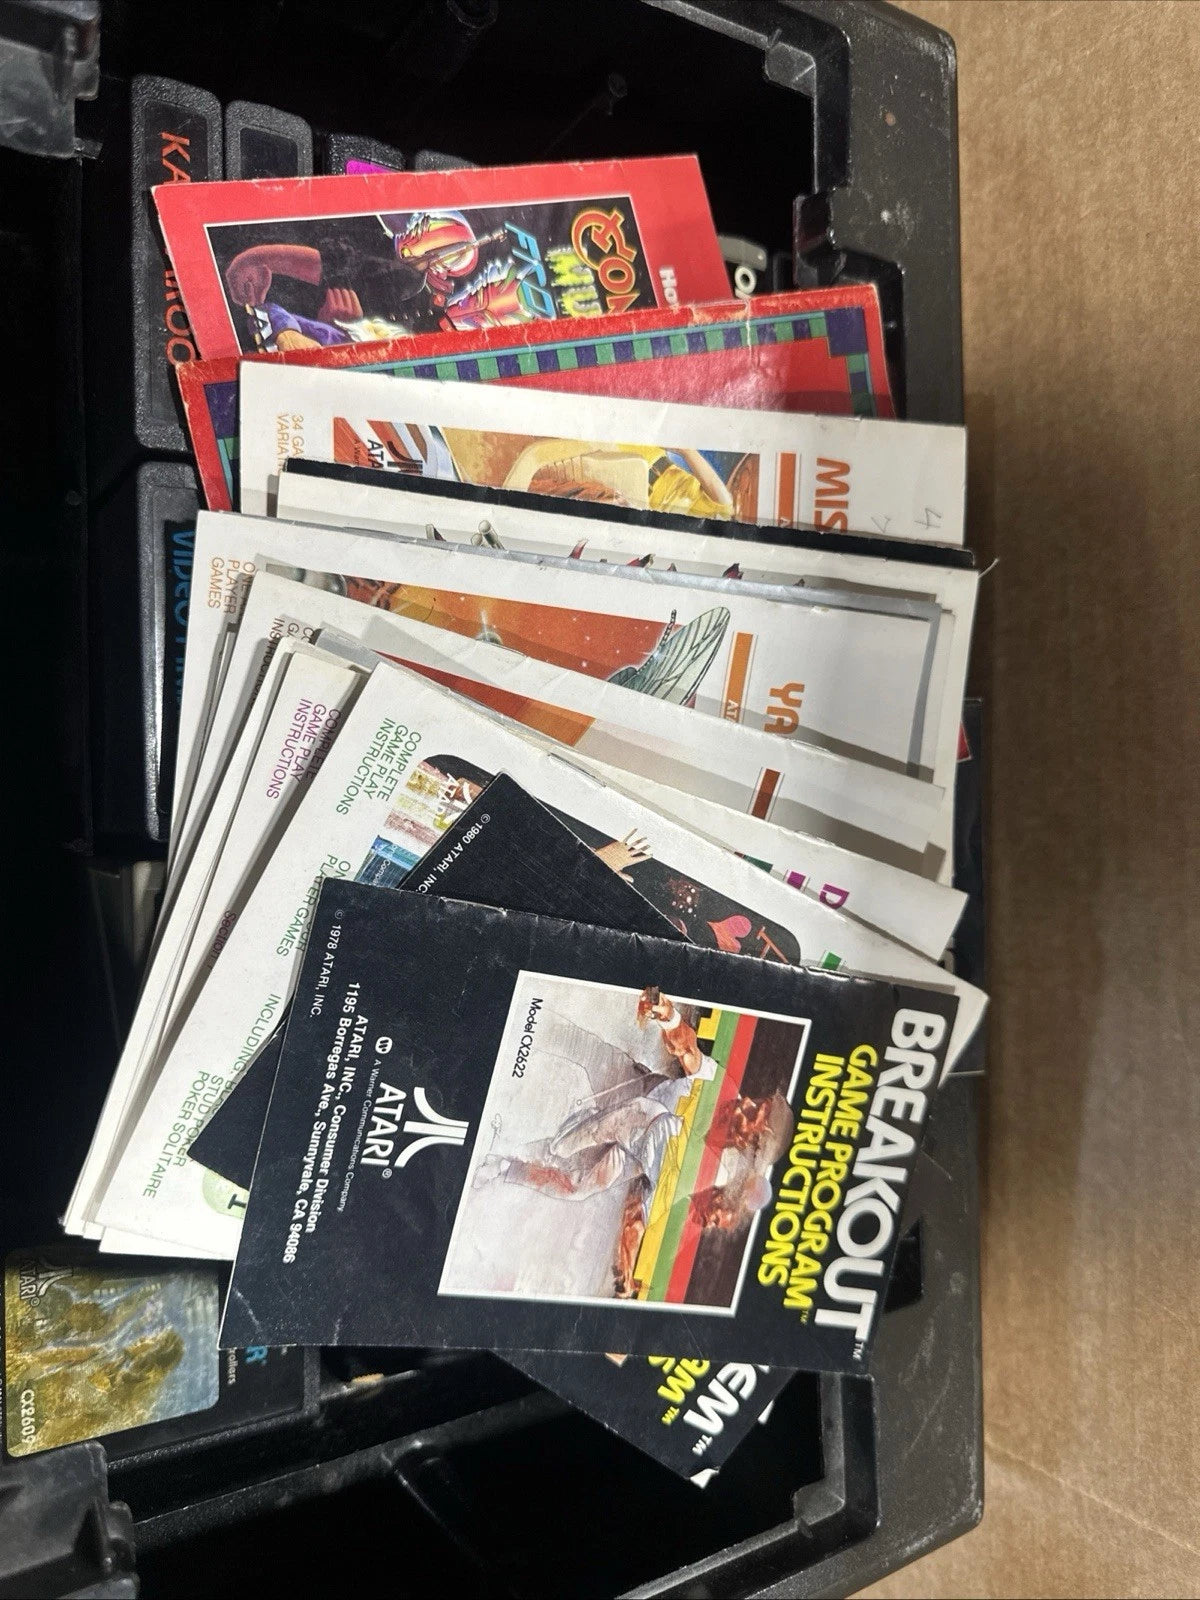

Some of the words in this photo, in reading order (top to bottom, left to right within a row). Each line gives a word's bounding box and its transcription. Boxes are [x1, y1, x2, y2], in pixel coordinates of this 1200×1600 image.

[291, 414, 305, 430] 34
[292, 436, 305, 457] GA
[814, 457, 851, 533] MIS
[208, 557, 225, 609] GAMES
[223, 560, 241, 615] PLAYER
[302, 703, 327, 744] GAME
[764, 682, 806, 736] YA
[266, 698, 312, 799] INSTRUCTIONS
[290, 747, 312, 784] PLAY
[305, 709, 342, 780] COMPLETE
[336, 717, 396, 815] INSTRUCTIONS
[377, 731, 422, 801] COMPLETE
[380, 724, 409, 766] GAME
[363, 765, 389, 800] PLAY
[432, 842, 464, 872] ATARI,
[461, 822, 484, 844] 1980
[415, 873, 438, 895] INC.
[276, 907, 311, 957] GAMES
[327, 924, 342, 950] 1978
[315, 951, 335, 991] ATARI,
[309, 994, 325, 1018] INC.
[342, 982, 361, 1013] 1195
[524, 997, 544, 1033] Model
[325, 1017, 353, 1079] Borregas
[345, 1014, 369, 1062] ATARI,
[511, 1034, 533, 1079] CX2622
[334, 1066, 357, 1100] INC.,
[365, 1068, 380, 1098] Warner
[373, 1059, 382, 1067] A
[177, 1071, 210, 1120] POKER
[198, 1075, 224, 1115] STUD
[314, 1083, 336, 1117] Ave.,
[828, 1044, 879, 1139] GAME
[318, 1104, 347, 1175] Consumer
[348, 1099, 372, 1170] Communications
[359, 1082, 408, 1166] ATARI
[143, 1122, 186, 1198] SOLITAIRE
[296, 1120, 327, 1195] Sunnyvale,
[757, 1053, 846, 1287] INSTRUCTIONS
[813, 1008, 947, 1341] BREAKOUT
[291, 1198, 308, 1220] CA
[305, 1178, 329, 1233] Division
[782, 1141, 855, 1312] PROGRAM
[282, 1223, 302, 1264] 94086
[20, 1389, 35, 1444] CX2609
